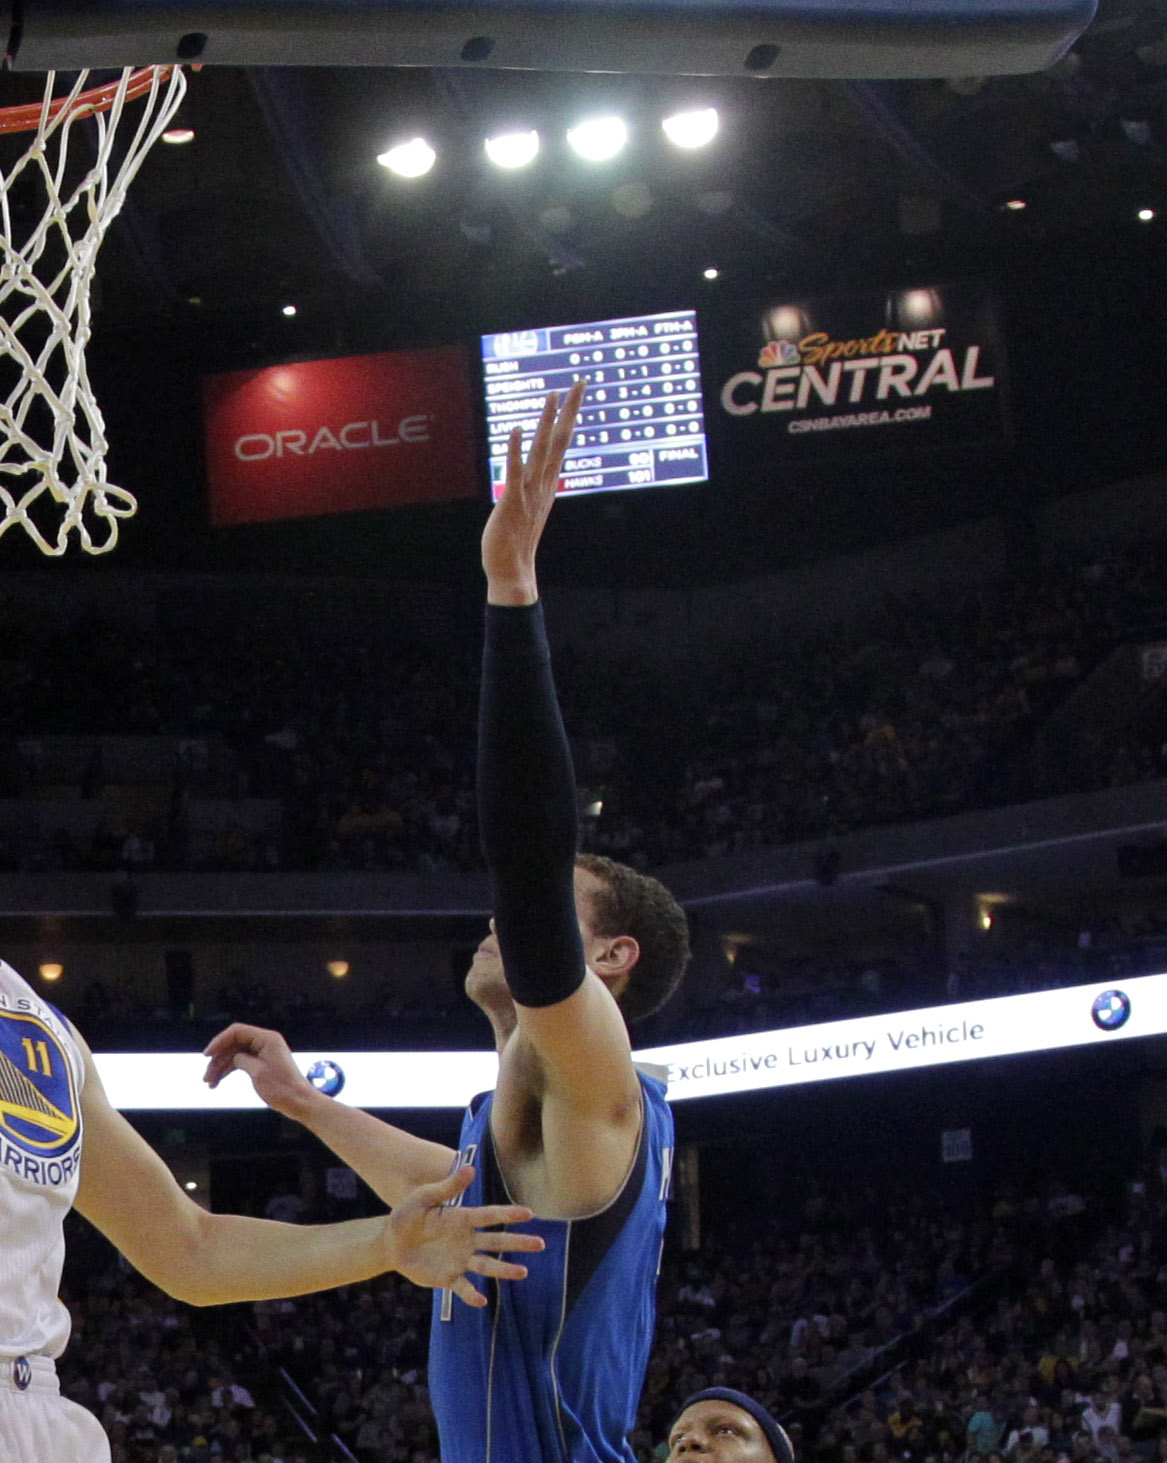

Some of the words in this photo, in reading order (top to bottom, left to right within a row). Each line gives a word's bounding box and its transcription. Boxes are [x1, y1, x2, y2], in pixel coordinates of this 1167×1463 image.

[720, 345, 995, 416] CENTRAL
[489, 397, 547, 414] THOMPSO
[787, 405, 932, 434] CSNBAYAREA.COM
[235, 415, 431, 461] ORACLE
[565, 457, 602, 471] BUCKS
[659, 448, 699, 462] FINAL
[564, 475, 603, 488] HAWKS
[22, 1037, 53, 1077] 11
[788, 1040, 876, 1065] Luxury
[887, 1020, 984, 1051] Vehicle
